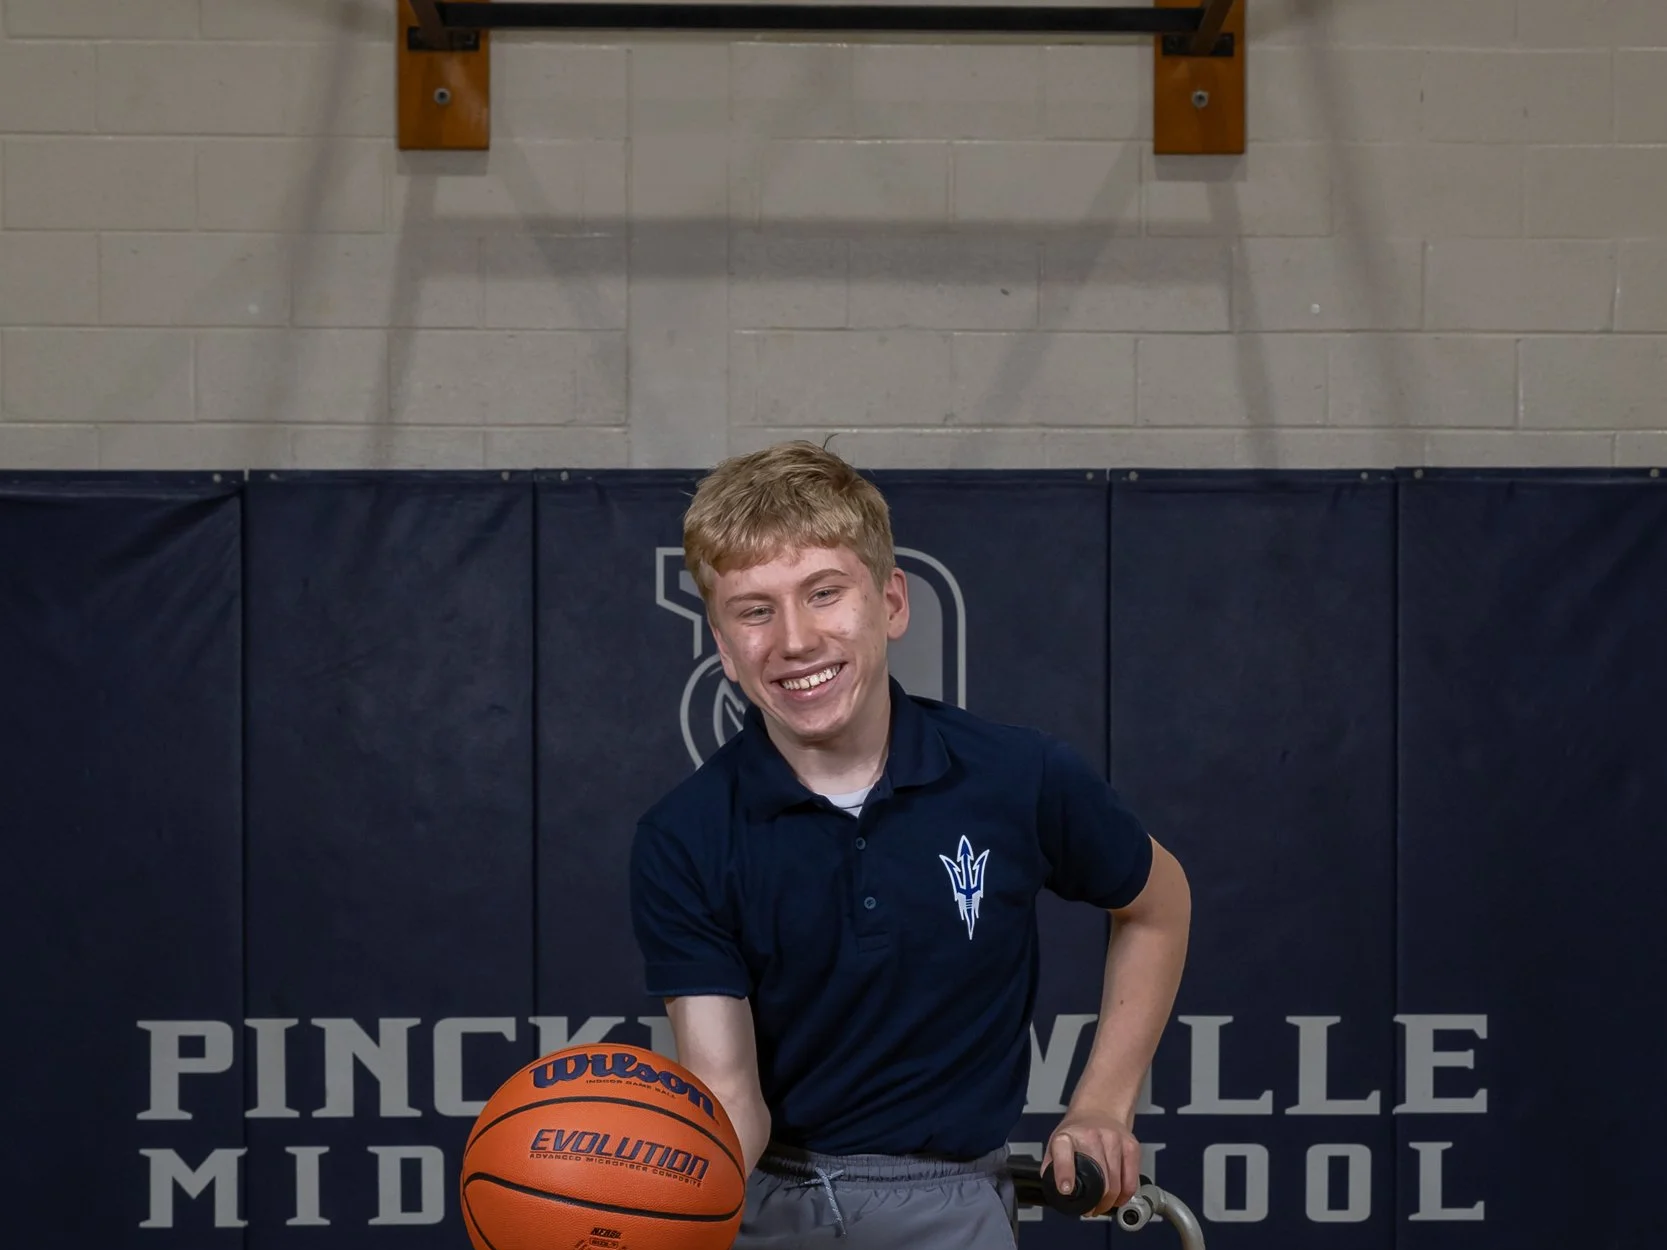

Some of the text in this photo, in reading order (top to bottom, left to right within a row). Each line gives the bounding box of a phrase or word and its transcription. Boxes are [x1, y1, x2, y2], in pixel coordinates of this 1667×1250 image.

[529, 1053, 720, 1126] Wilson
[529, 1128, 710, 1180] EVOLUTION
[529, 1153, 702, 1189] ADVANCED MICROFIBER COMPOSITE
[139, 1145, 446, 1228] MID
